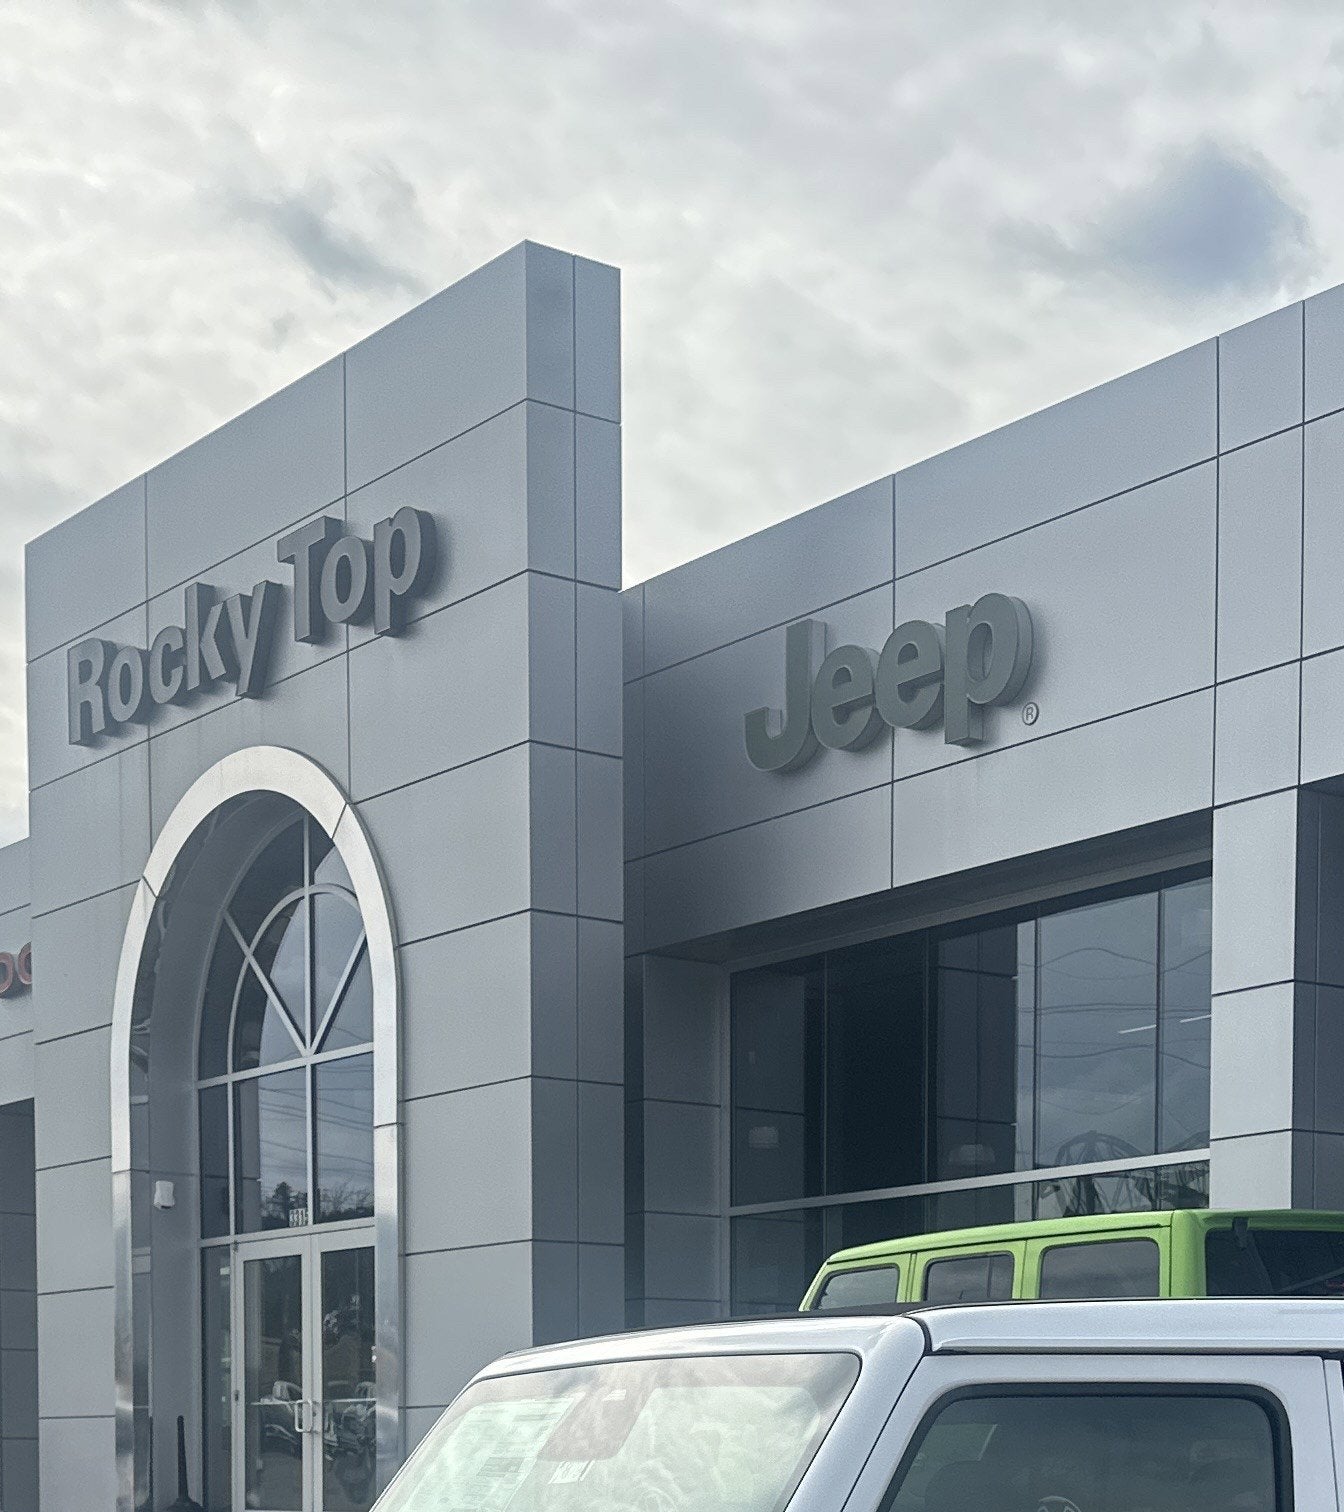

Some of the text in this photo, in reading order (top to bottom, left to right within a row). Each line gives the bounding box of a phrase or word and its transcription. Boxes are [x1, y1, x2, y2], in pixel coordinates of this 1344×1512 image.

[67, 505, 439, 746] Rocky Top
[744, 592, 1034, 772] Jeep
